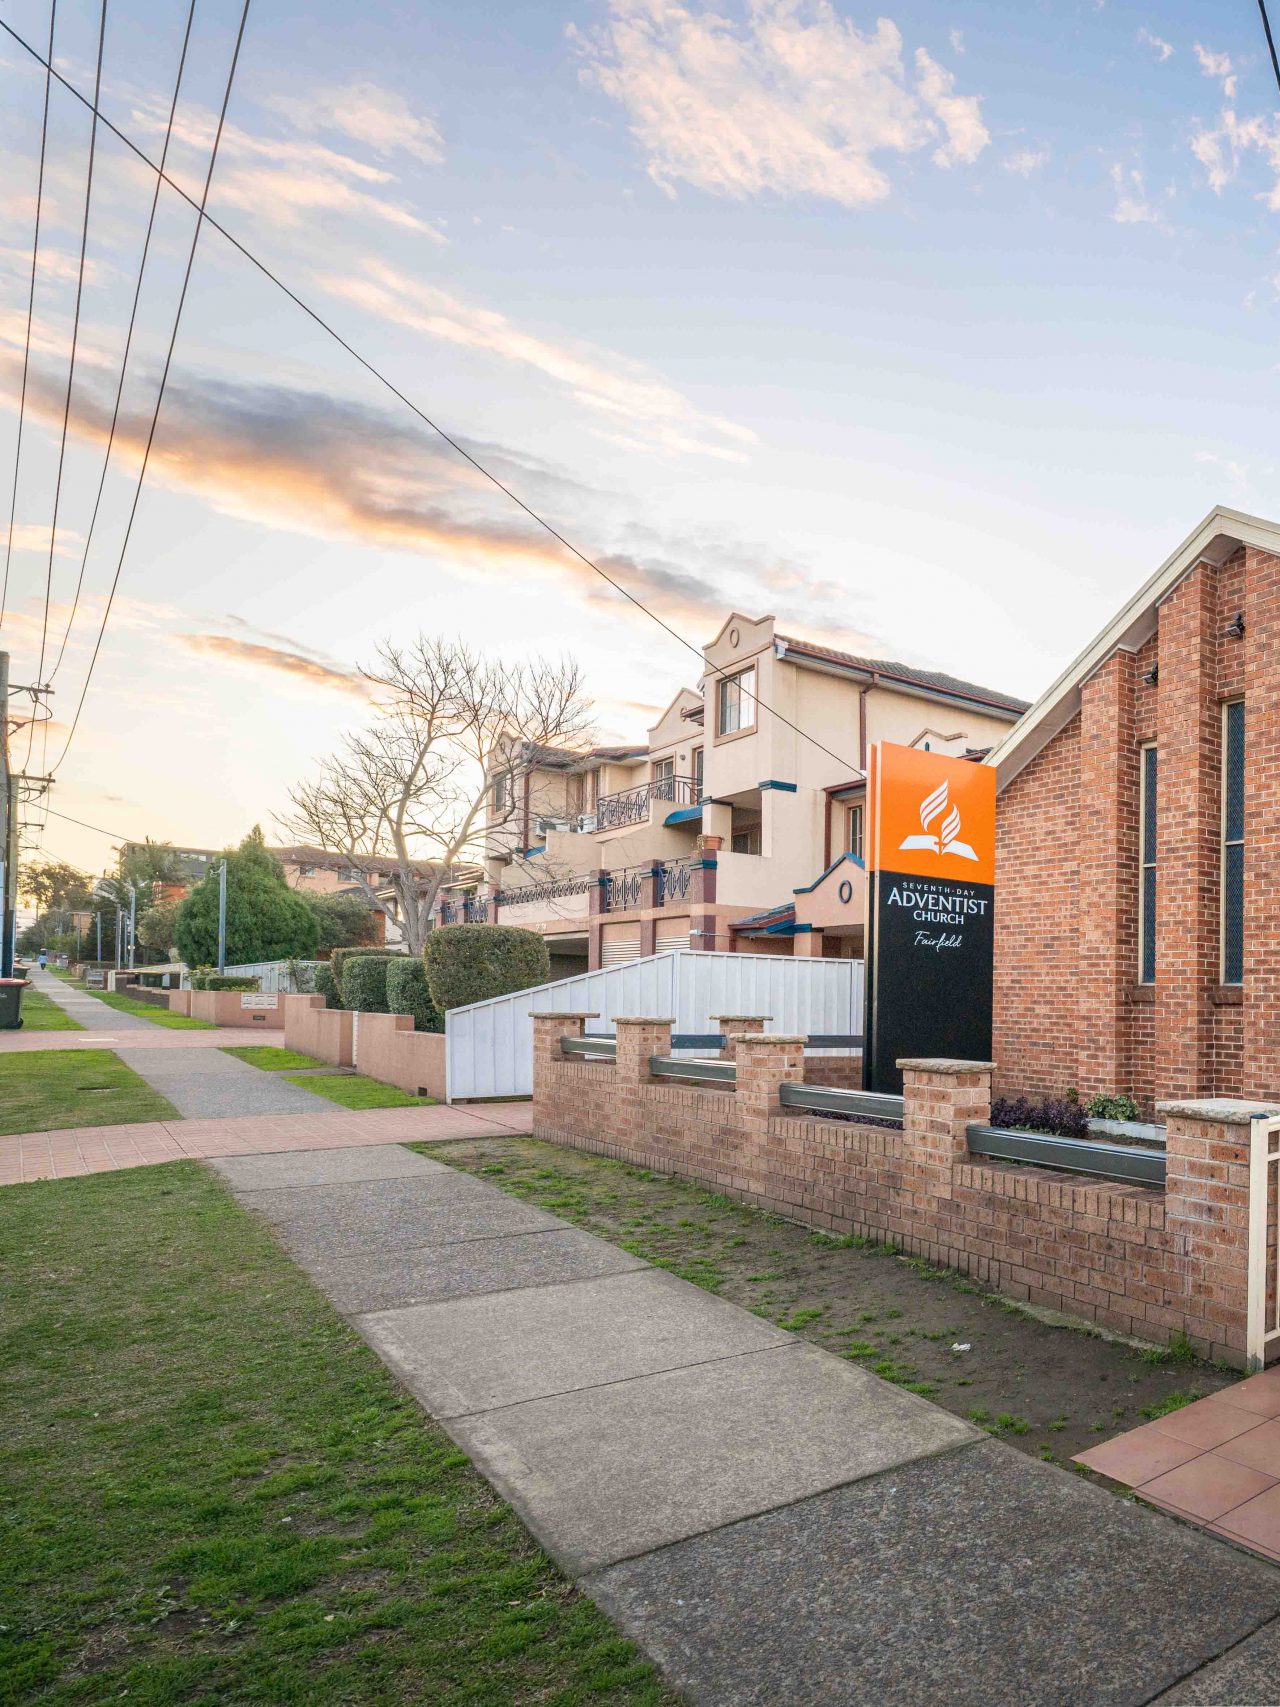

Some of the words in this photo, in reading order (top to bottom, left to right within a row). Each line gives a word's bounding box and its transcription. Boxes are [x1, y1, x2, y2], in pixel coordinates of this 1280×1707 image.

[887, 887, 988, 915] ADVENTIST
[913, 910, 965, 925] CHURCH
[914, 930, 963, 953] Fairfield
